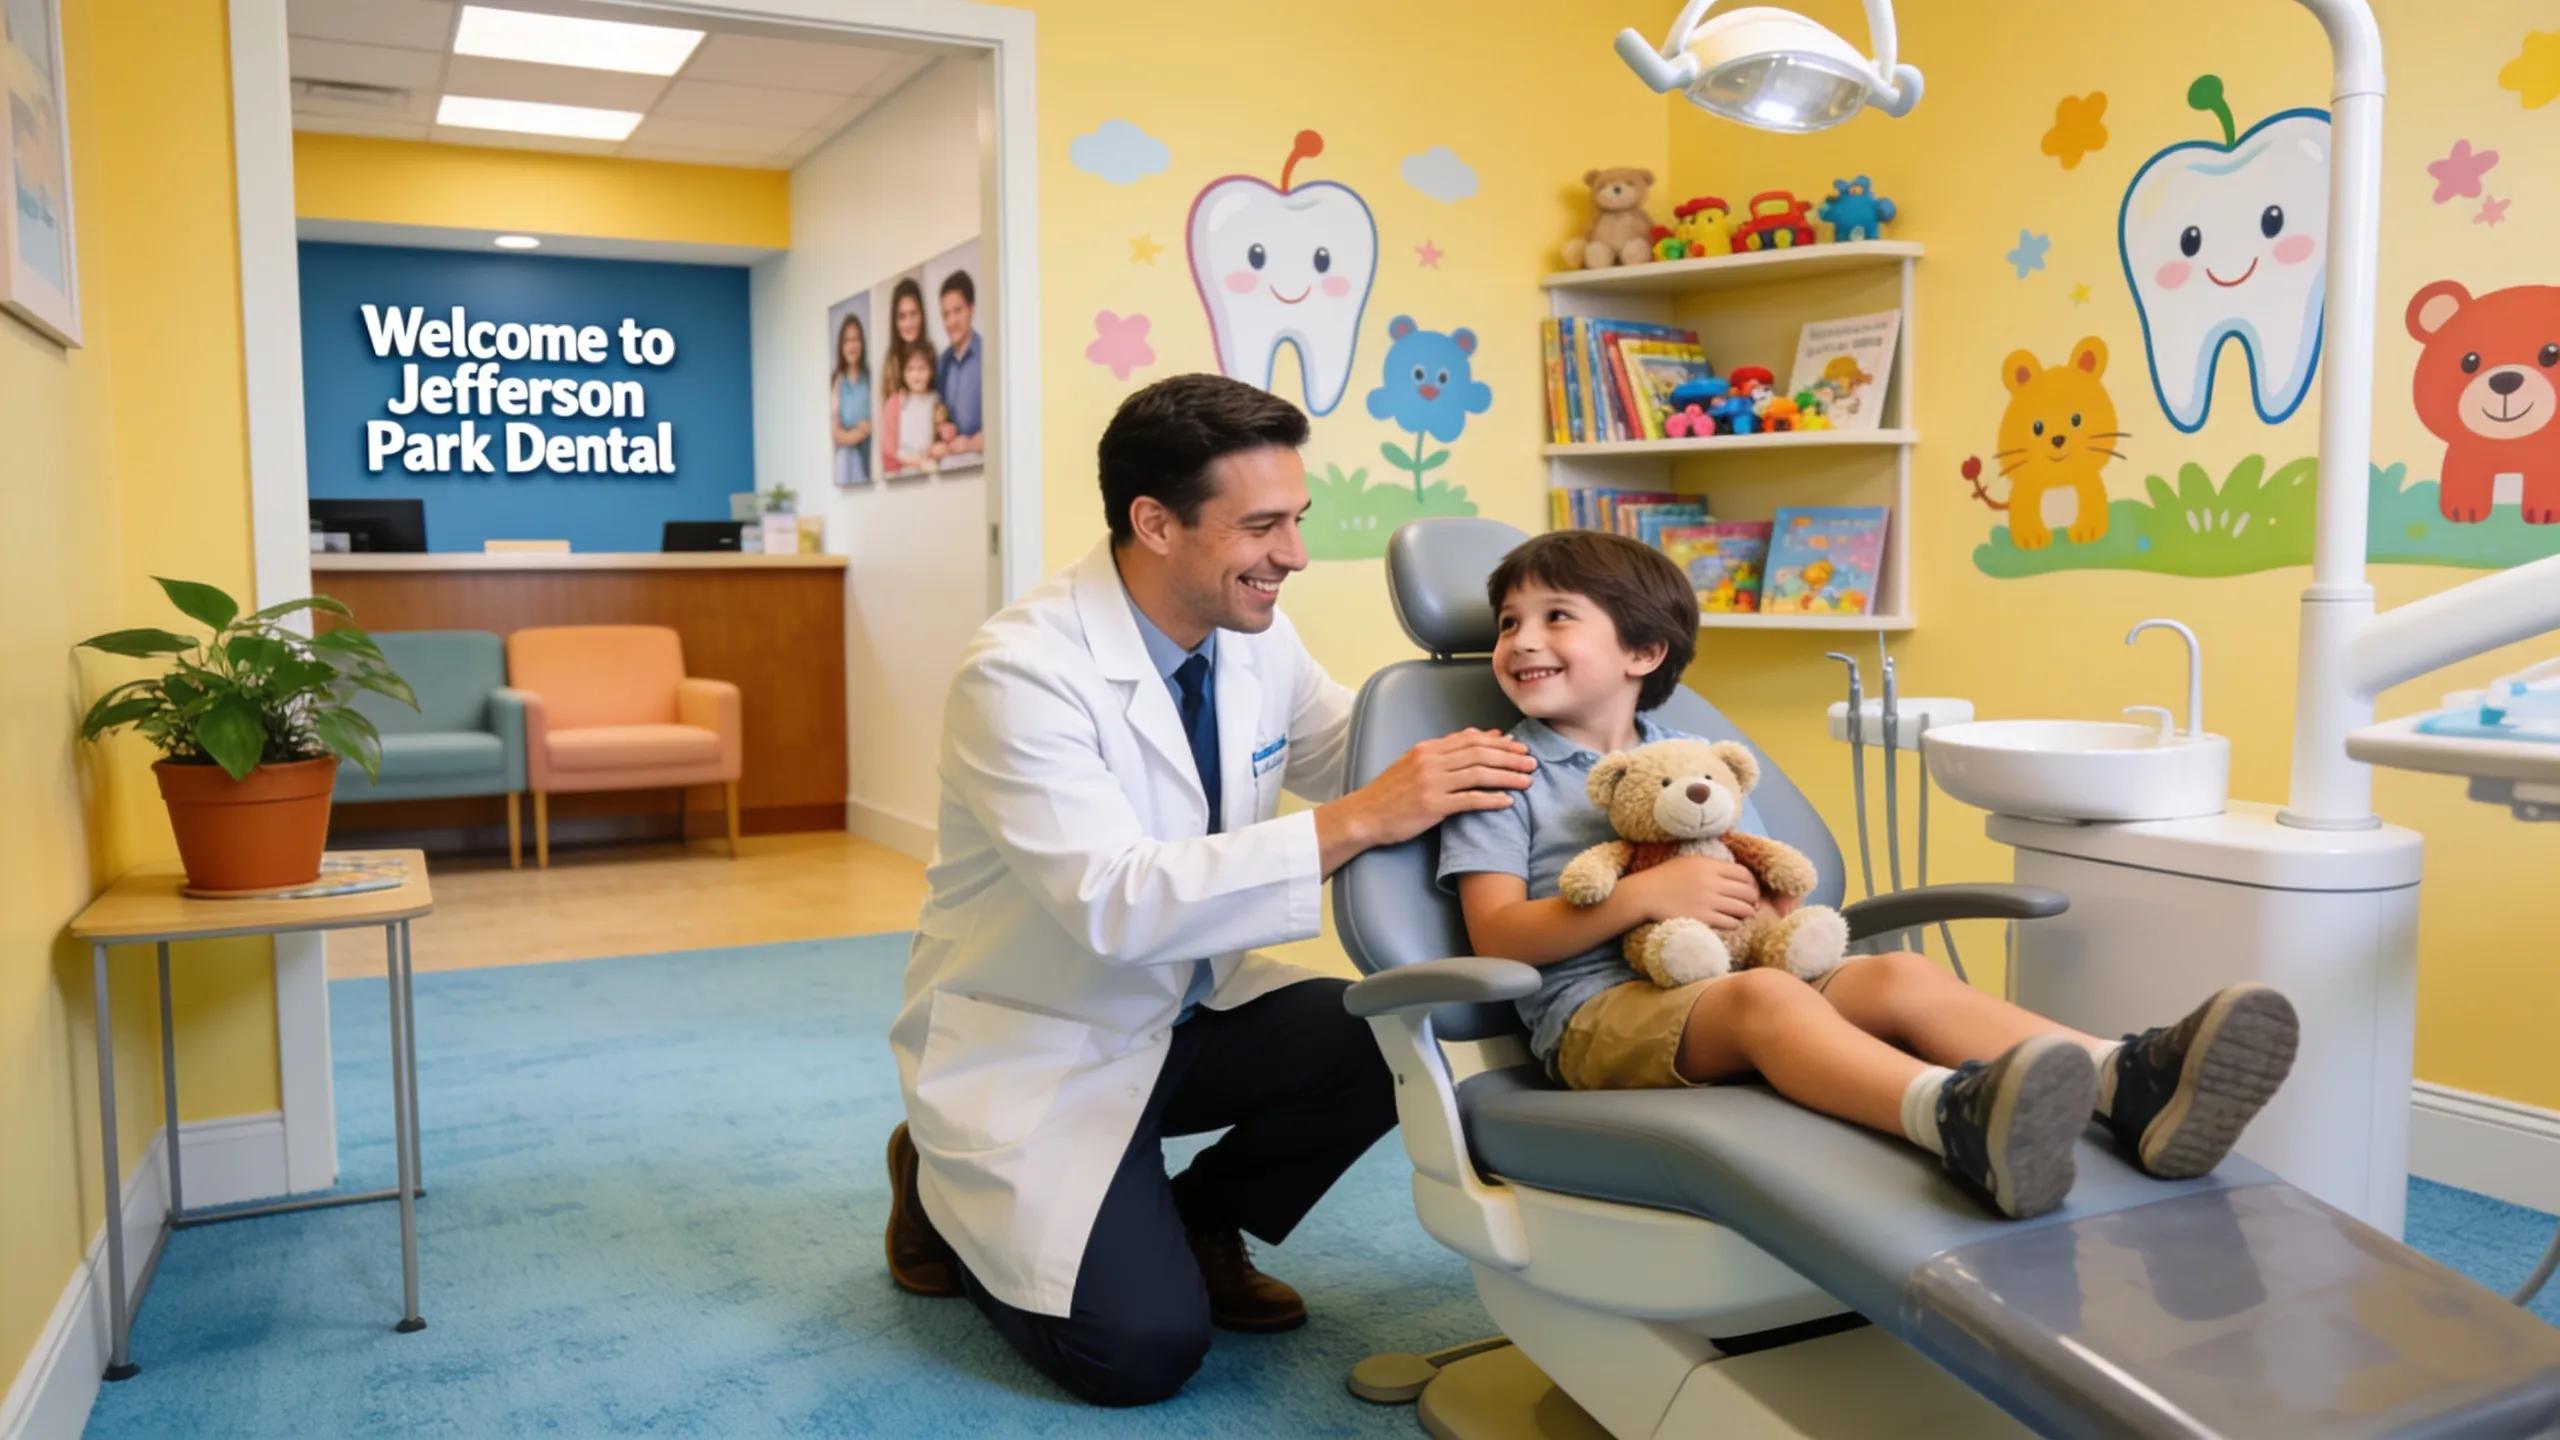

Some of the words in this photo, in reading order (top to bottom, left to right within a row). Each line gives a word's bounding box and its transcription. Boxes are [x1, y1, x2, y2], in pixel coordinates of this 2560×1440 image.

[361, 303, 608, 363] Welcome
[618, 318, 676, 366] to
[387, 362, 645, 418] Jefferson
[367, 420, 496, 473] Park
[506, 421, 676, 474] Dental
